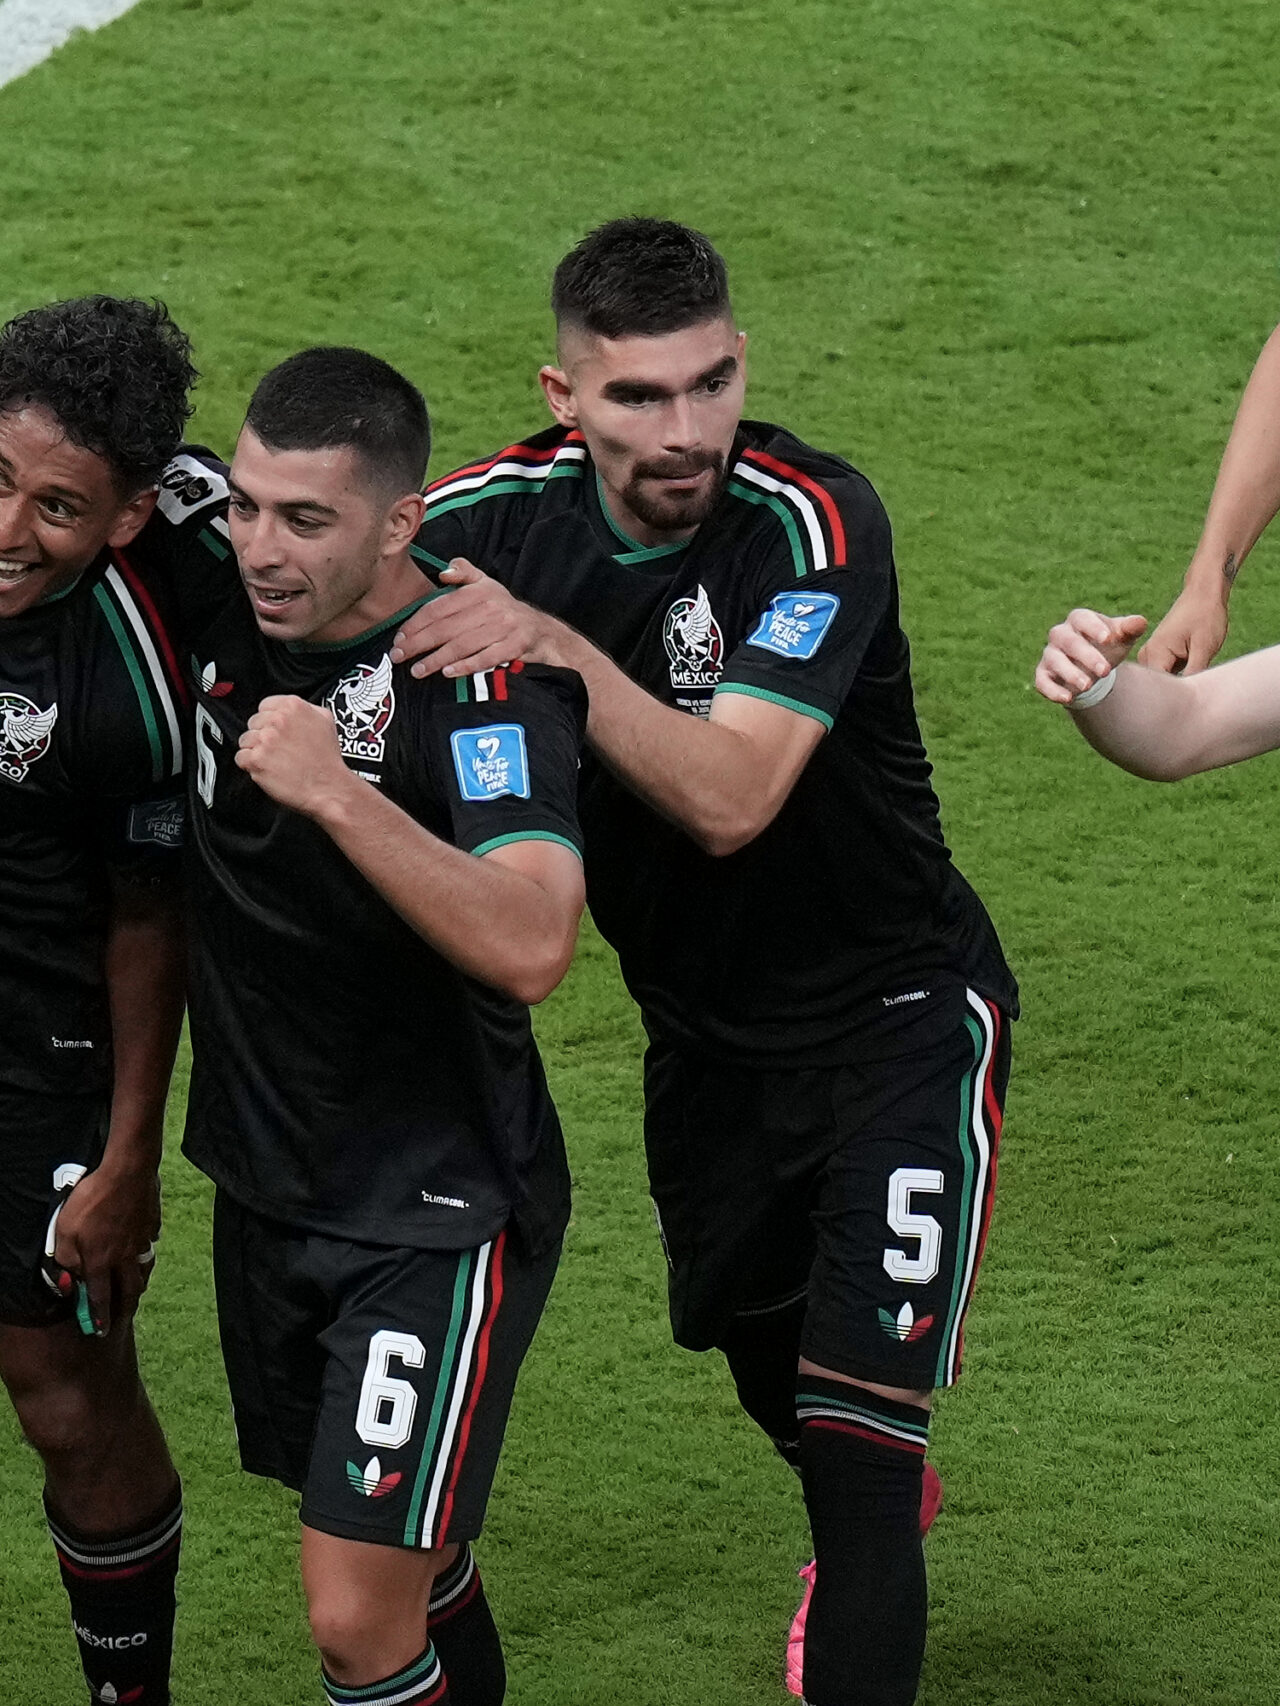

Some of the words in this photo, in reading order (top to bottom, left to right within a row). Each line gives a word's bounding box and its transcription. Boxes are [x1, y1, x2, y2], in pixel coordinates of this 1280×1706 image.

[769, 620, 802, 646] PEACE
[196, 702, 224, 809] 6
[477, 768, 508, 786] PEACE
[148, 821, 181, 835] PEACE
[882, 1168, 945, 1284] 5
[355, 1329, 425, 1449] 6
